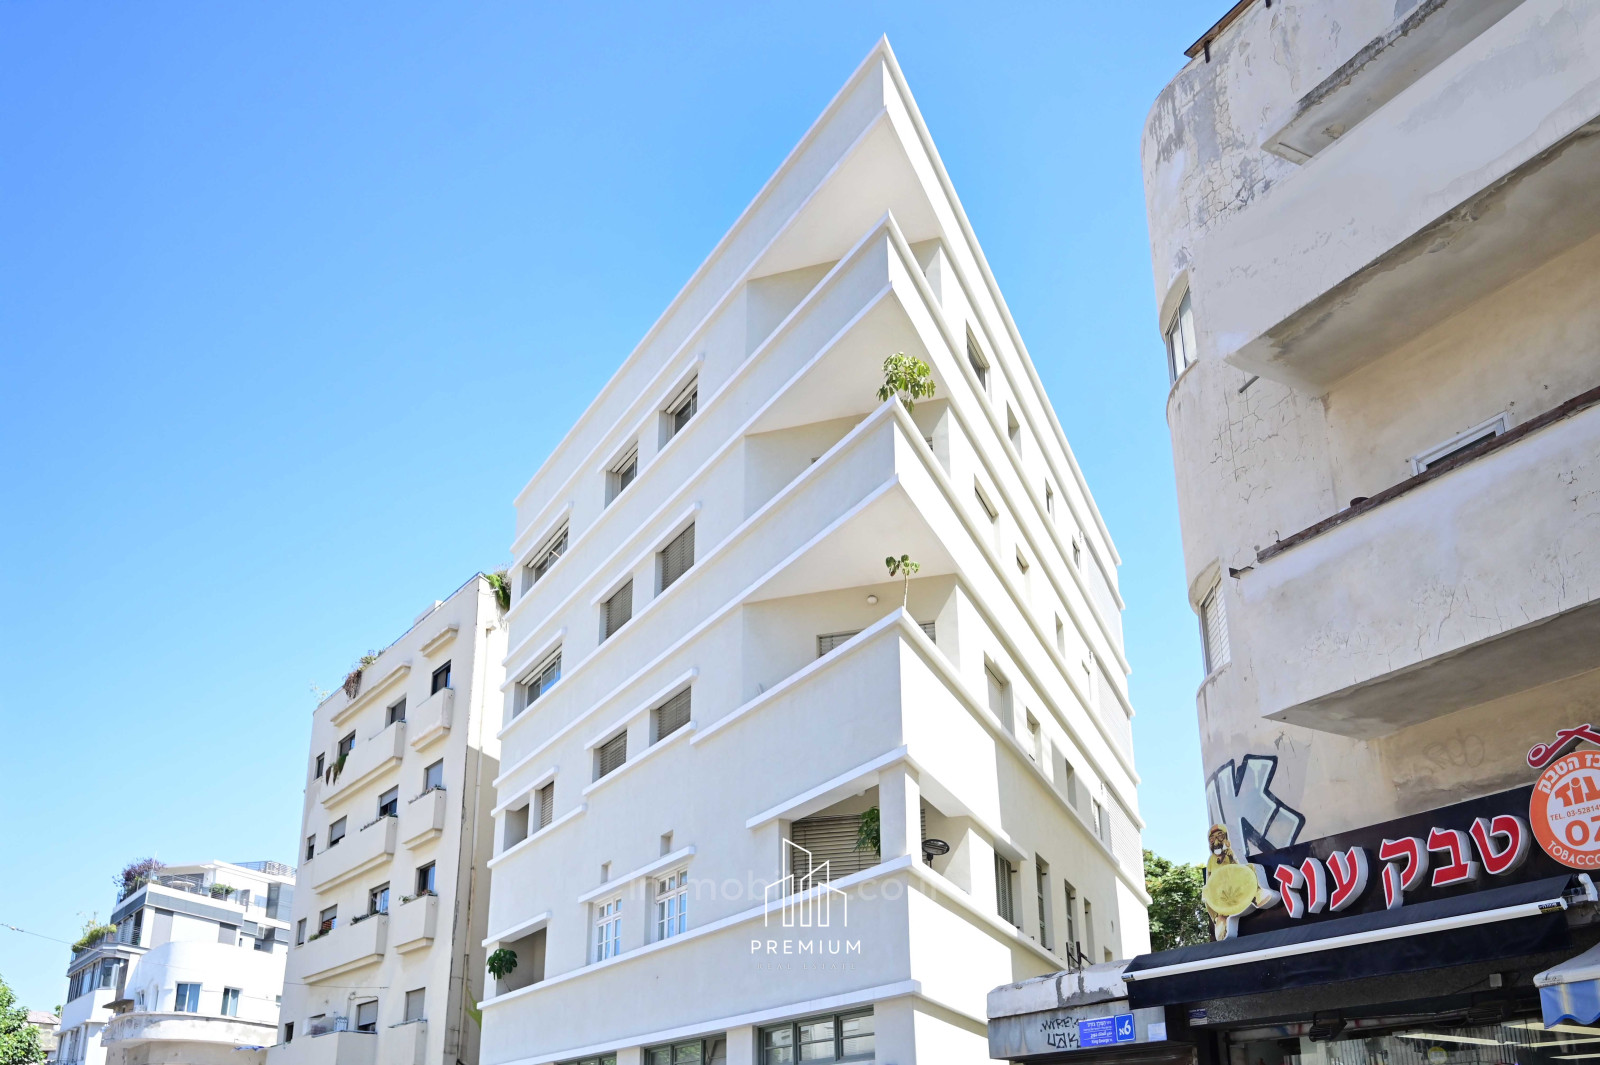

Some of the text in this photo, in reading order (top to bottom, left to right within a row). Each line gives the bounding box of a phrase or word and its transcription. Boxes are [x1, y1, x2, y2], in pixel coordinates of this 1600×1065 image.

[1538, 756, 1580, 795] הטבק
[1566, 803, 1600, 818] 03-52814
[1274, 814, 1531, 919] טבק עוז
